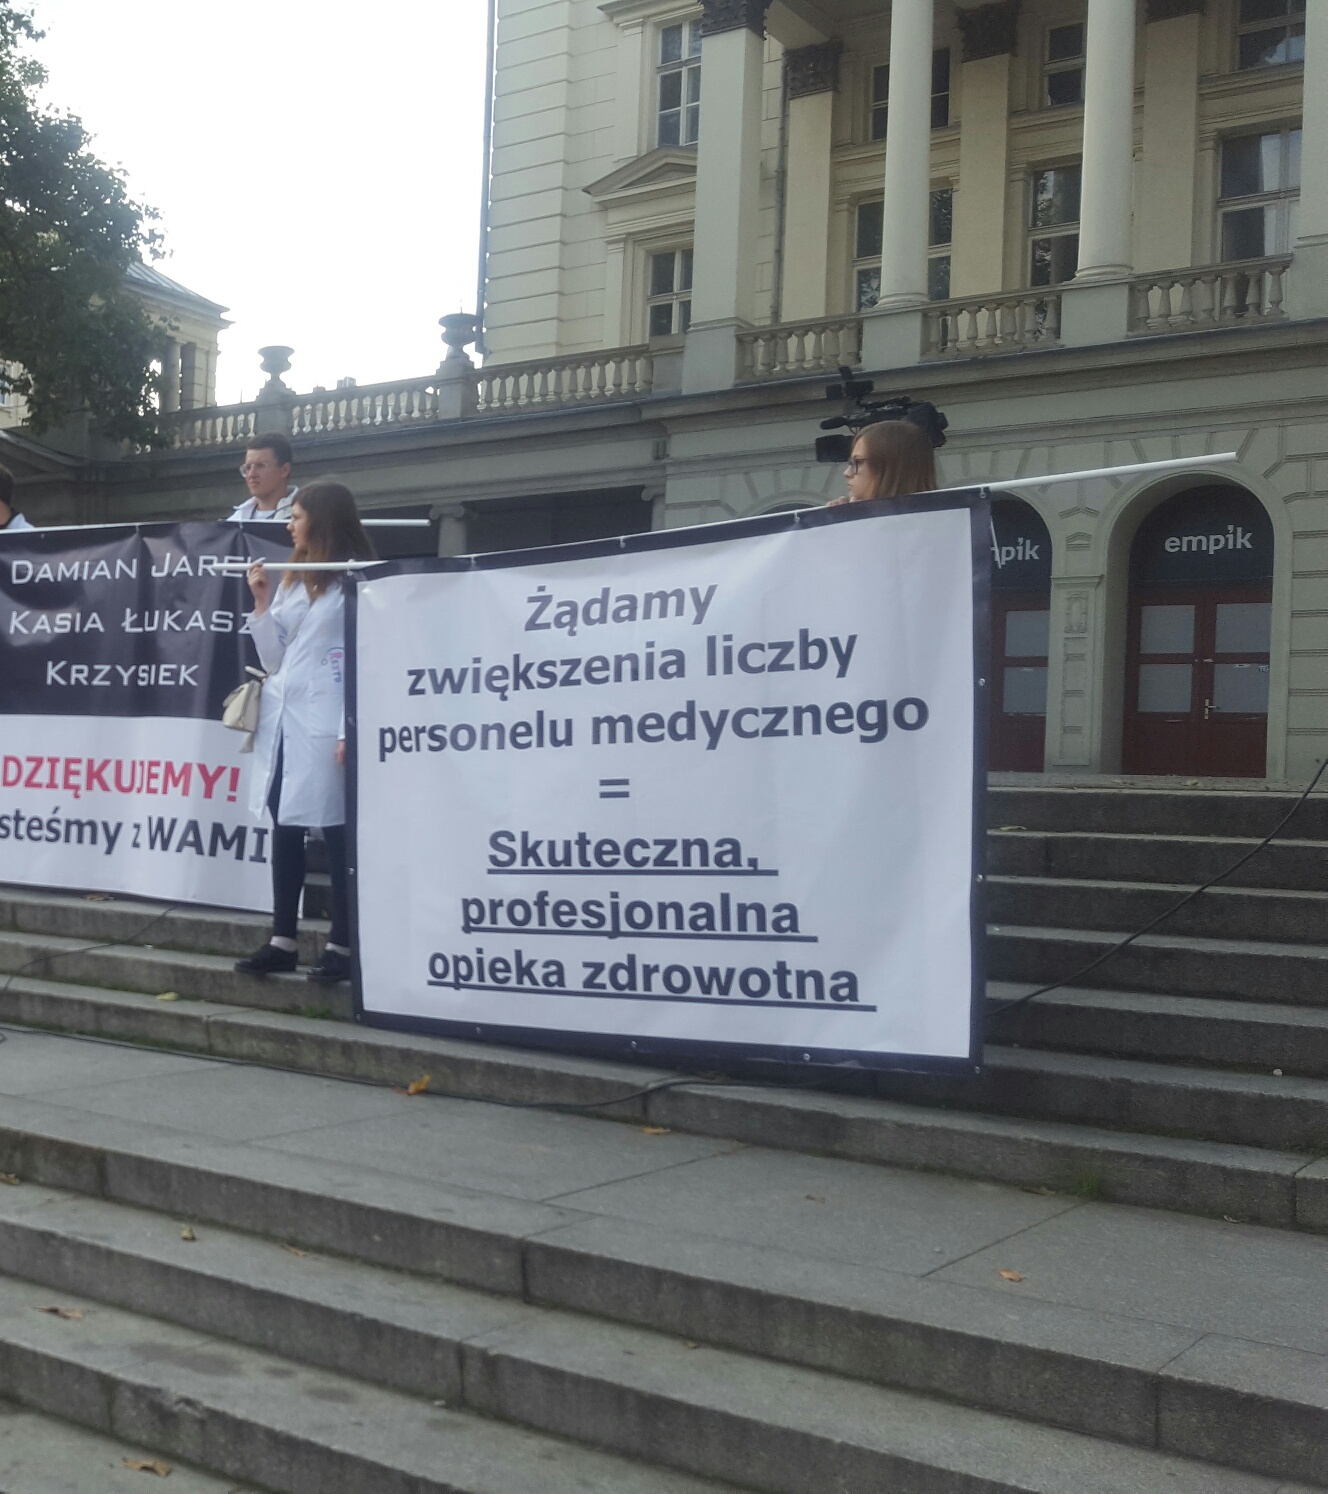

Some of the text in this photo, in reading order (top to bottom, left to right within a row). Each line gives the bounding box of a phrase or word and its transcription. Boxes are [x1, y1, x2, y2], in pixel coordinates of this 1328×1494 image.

[990, 537, 1040, 566] pik
[1164, 525, 1253, 554] empik
[11, 558, 138, 584] DAMIAN
[9, 610, 105, 635] KASIA
[524, 584, 718, 636] Żądamy
[46, 660, 199, 687] KRZYSIEK
[407, 640, 686, 701] zwiększenia
[706, 628, 859, 678] liczby
[378, 696, 929, 762] personelu medycznego
[2, 755, 241, 802] DZIĘKUJEMY!
[131, 822, 141, 848] z
[488, 830, 759, 871] Skuteczna,
[461, 891, 800, 939] profesjonalna
[428, 947, 860, 1003] opieka zdrowotna
